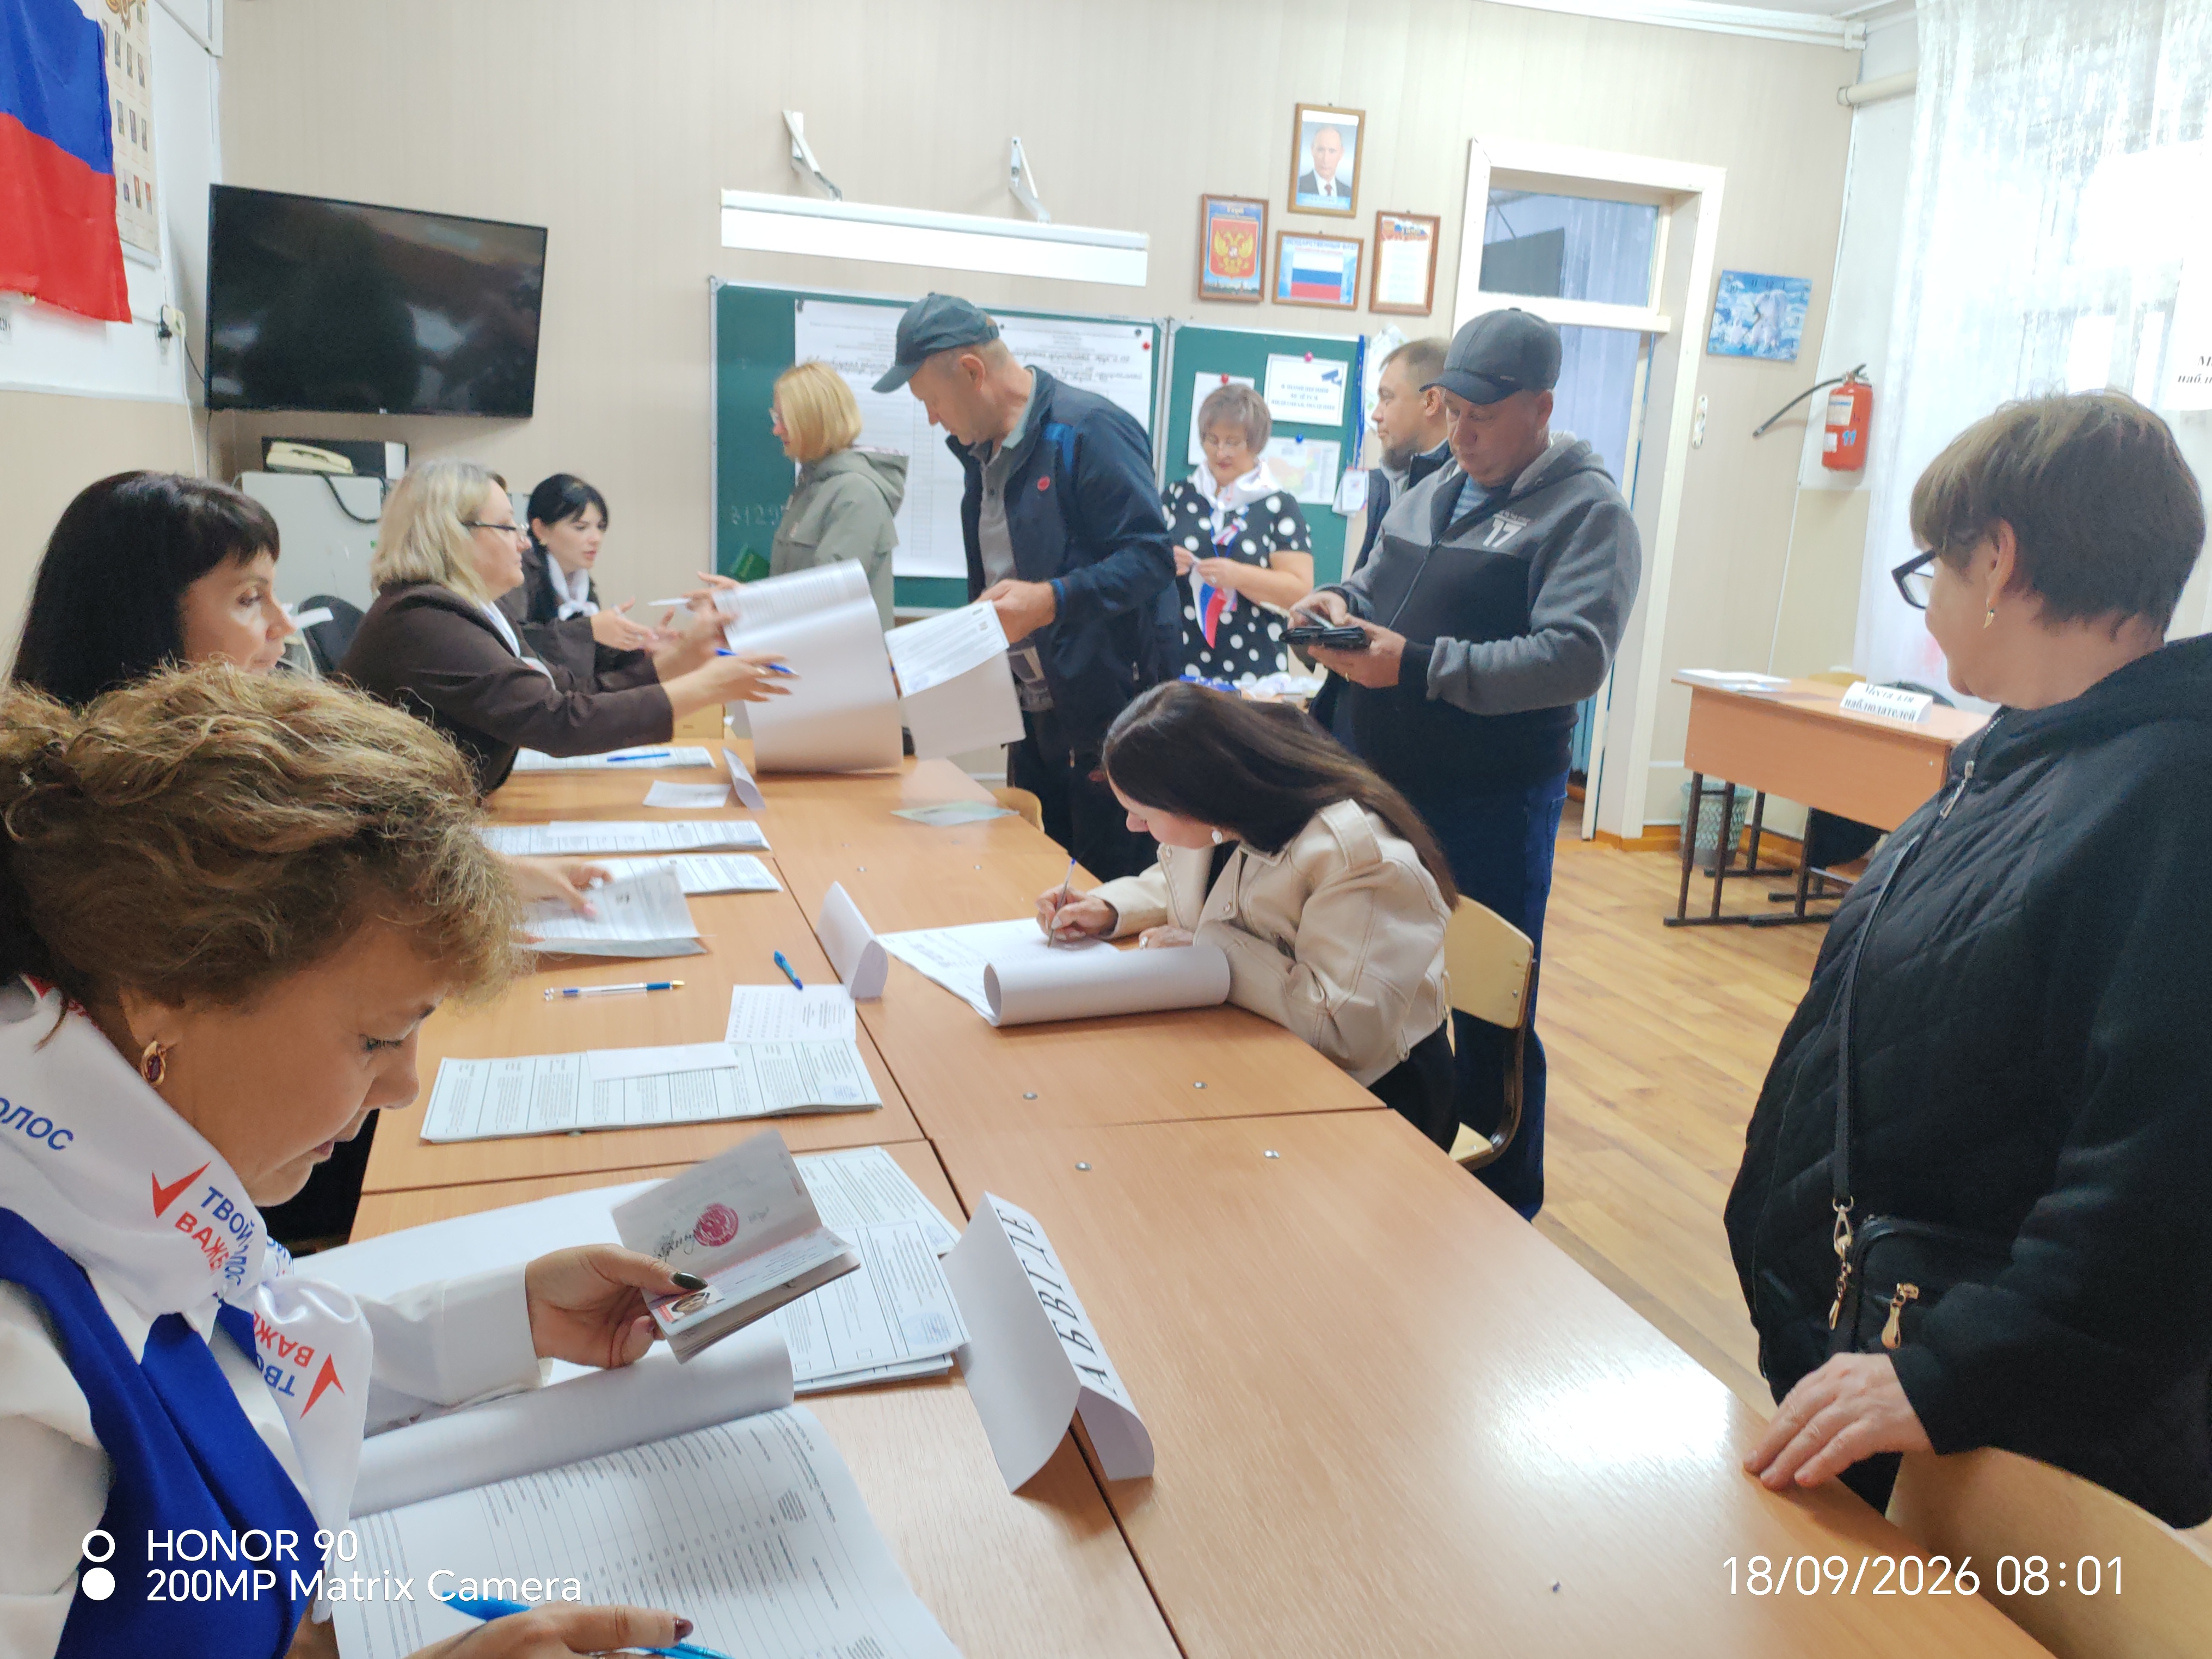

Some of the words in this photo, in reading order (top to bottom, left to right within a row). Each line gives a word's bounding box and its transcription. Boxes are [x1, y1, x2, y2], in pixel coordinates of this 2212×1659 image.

[2198, 355, 2212, 367] М
[1482, 518, 1522, 549] 17
[1845, 698, 1916, 722] наблюдателей
[175, 1210, 229, 1276] ВАЖЕ
[253, 1310, 315, 1368] ВАЖ
